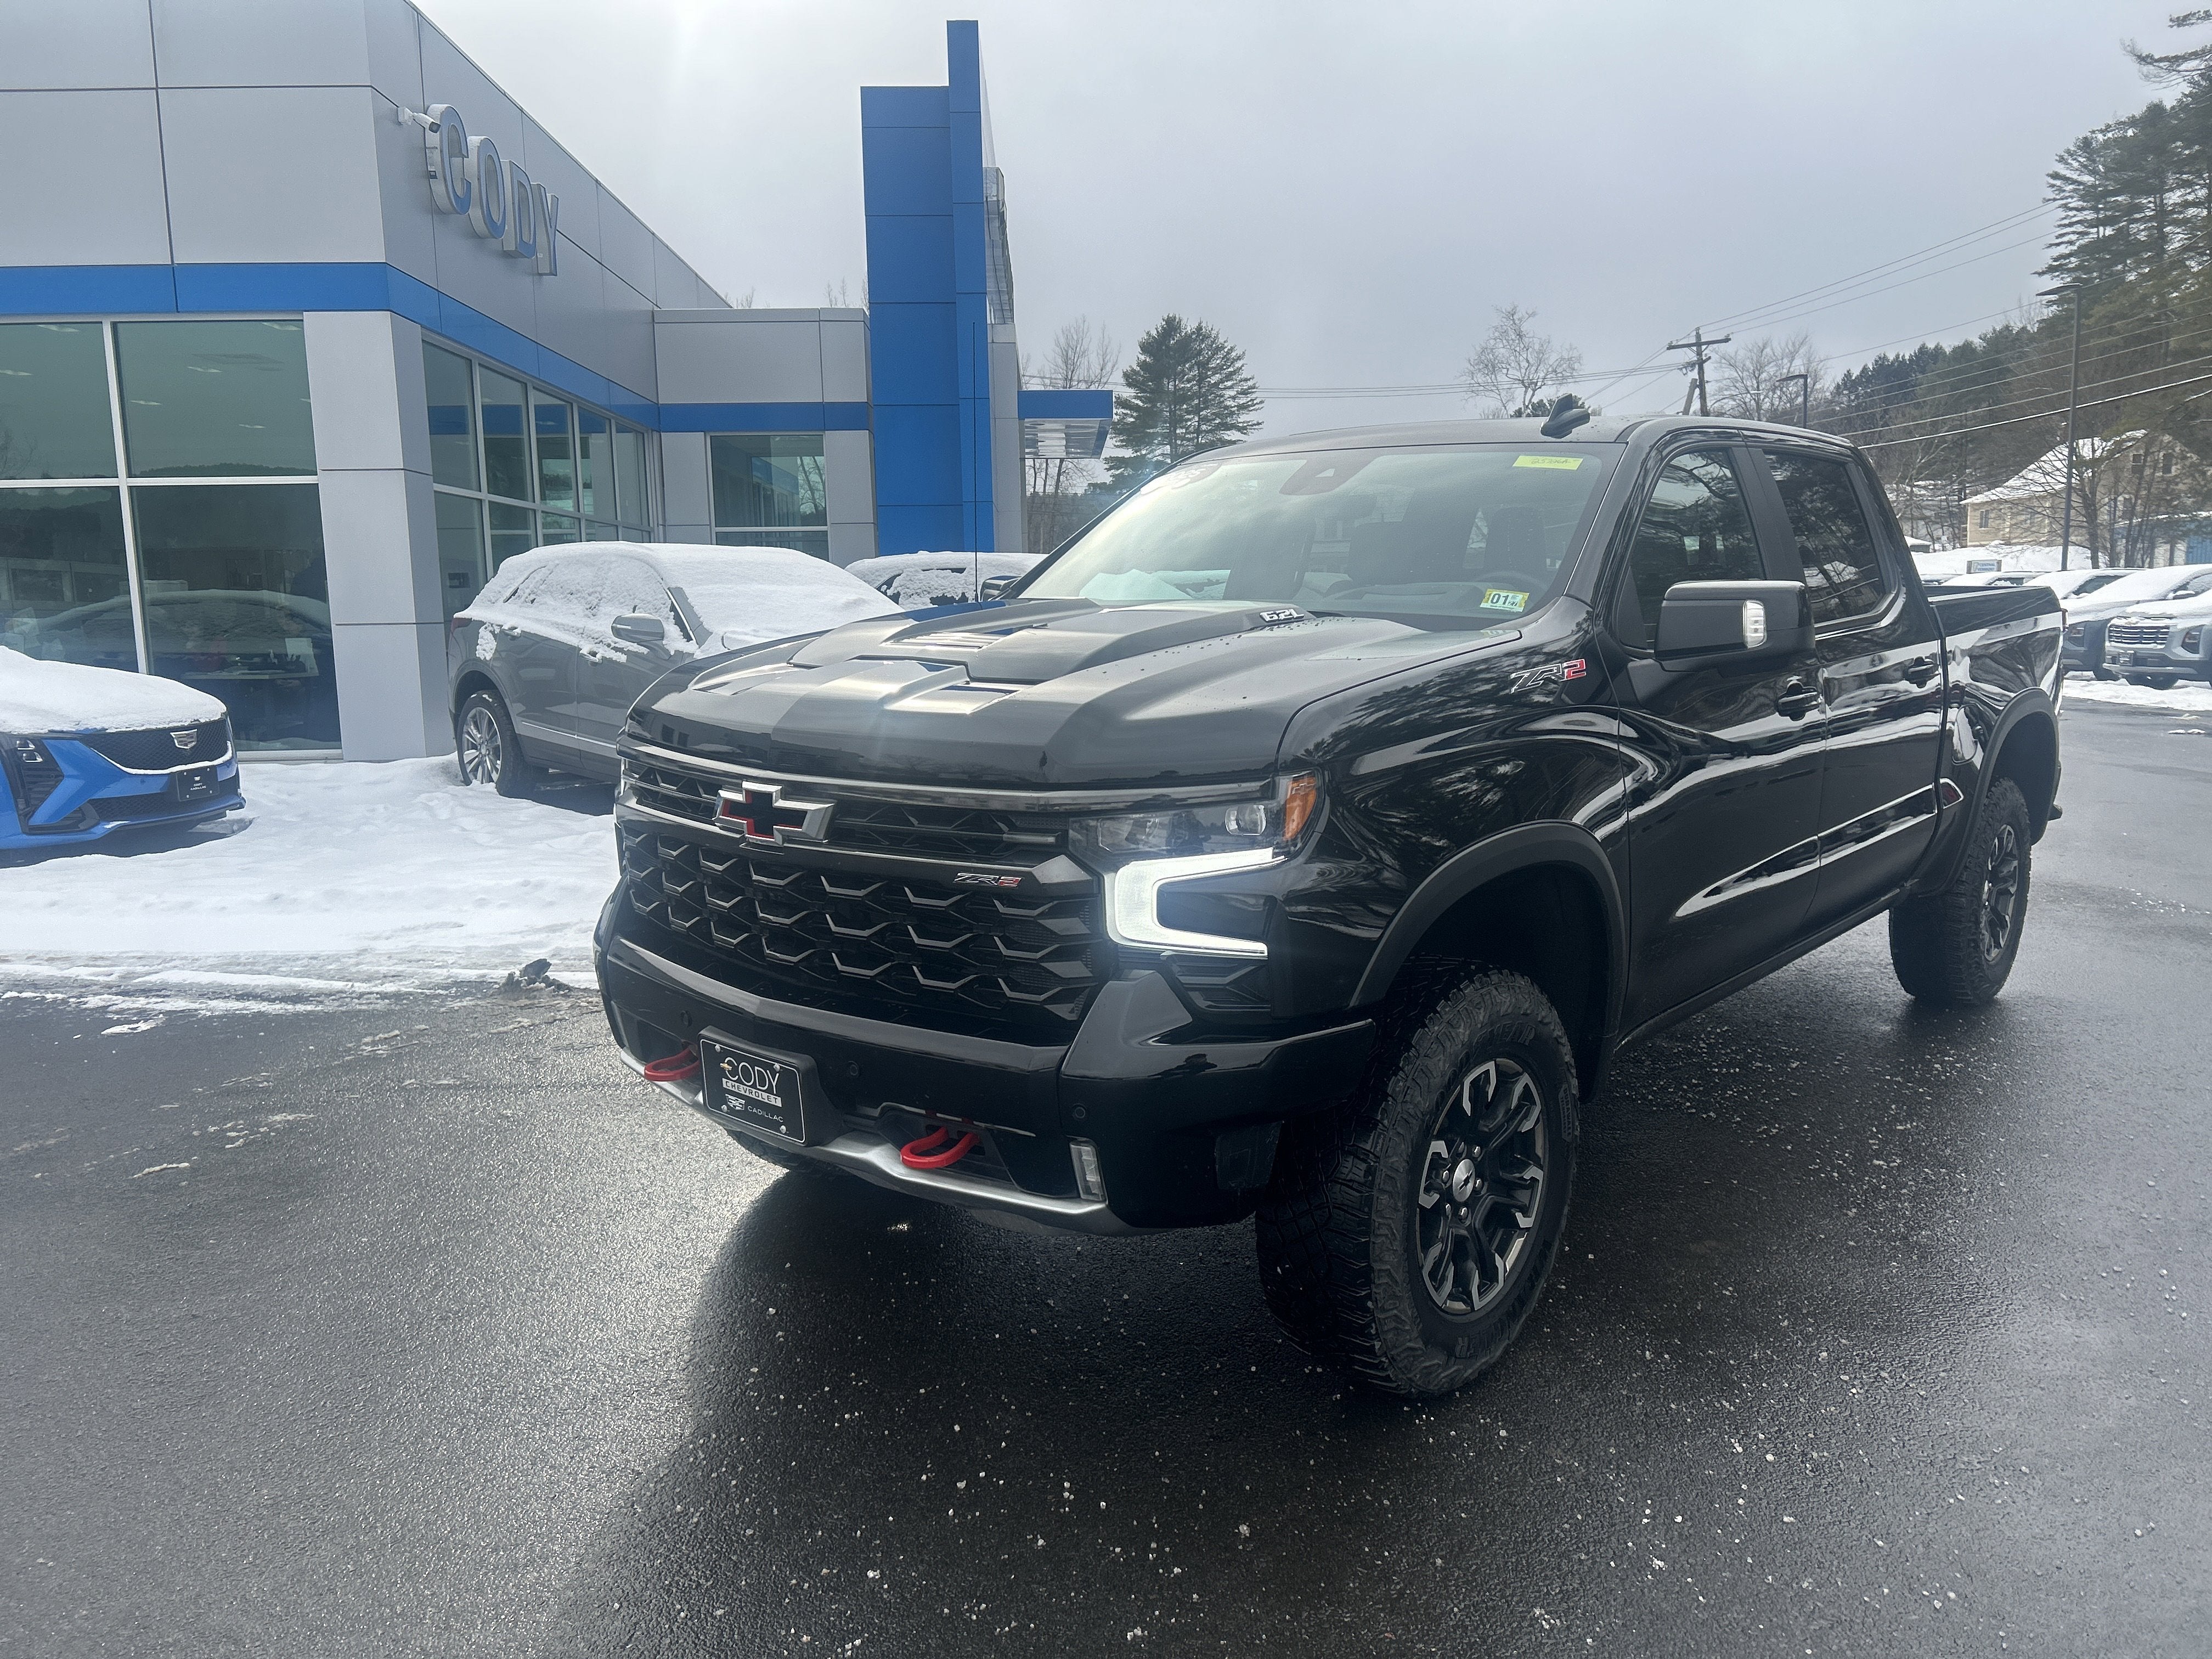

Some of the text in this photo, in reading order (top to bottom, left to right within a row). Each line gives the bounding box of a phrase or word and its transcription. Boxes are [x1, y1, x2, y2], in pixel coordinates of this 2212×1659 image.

[425, 104, 559, 276] CODY
[1510, 658, 1587, 694] ZR2
[953, 872, 1023, 888] ZR2
[723, 1057, 779, 1094] CODY
[725, 1081, 778, 1104] CHEVROLET
[747, 1105, 783, 1122] CADILLAC
